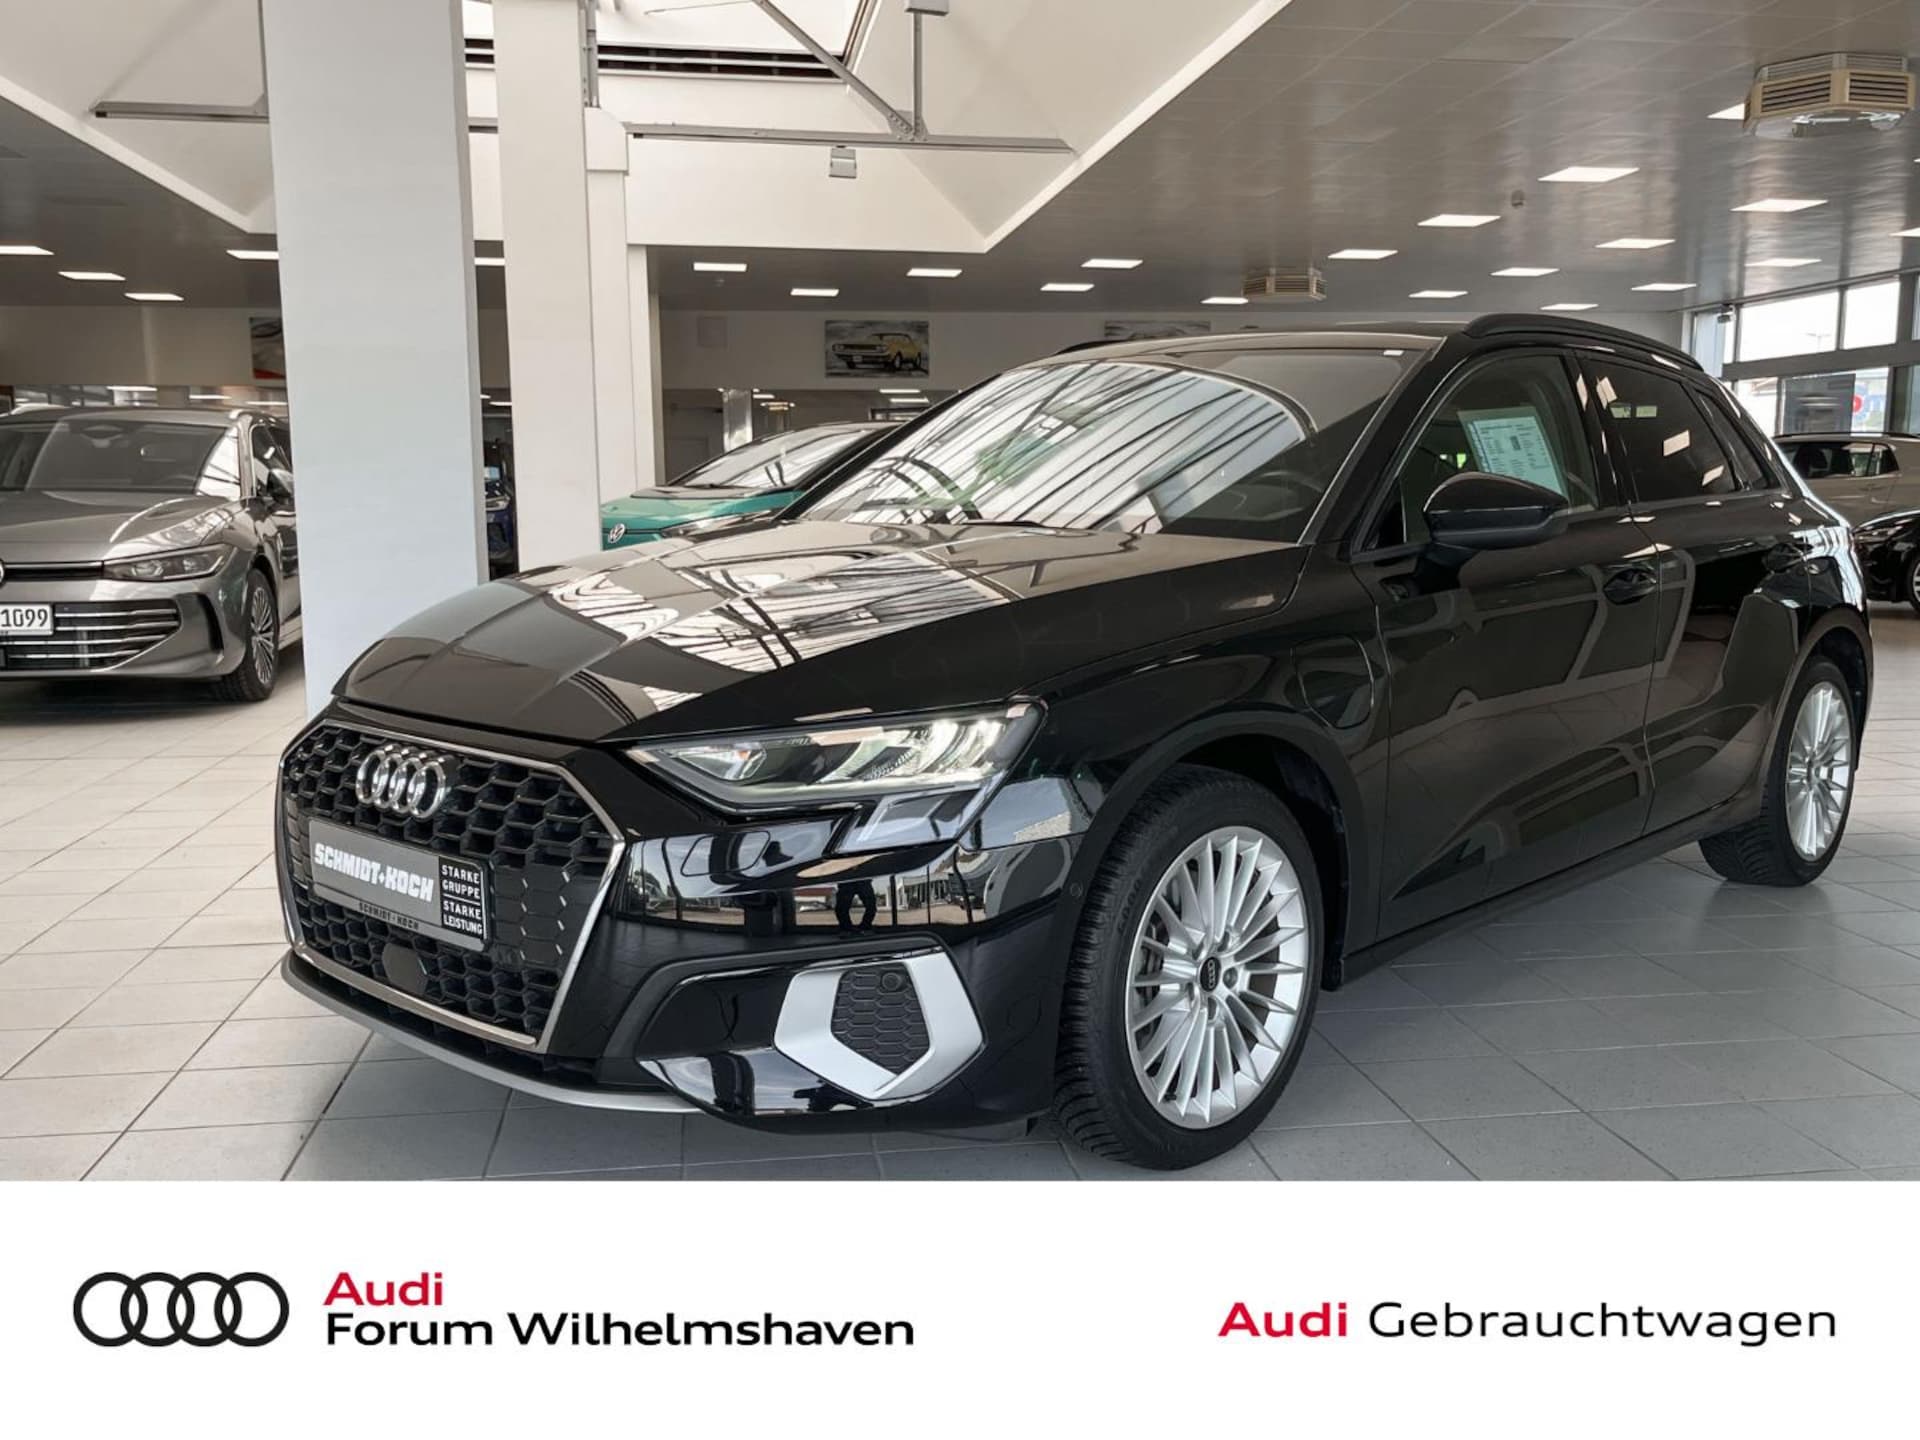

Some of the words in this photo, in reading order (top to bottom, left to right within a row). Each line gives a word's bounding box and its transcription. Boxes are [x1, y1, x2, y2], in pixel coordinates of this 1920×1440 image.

[0, 608, 49, 627] 1099
[441, 864, 480, 884] STARKE
[442, 880, 481, 899] GRUPPE
[443, 901, 482, 920] STARKE
[443, 914, 483, 935] LEISTUNG
